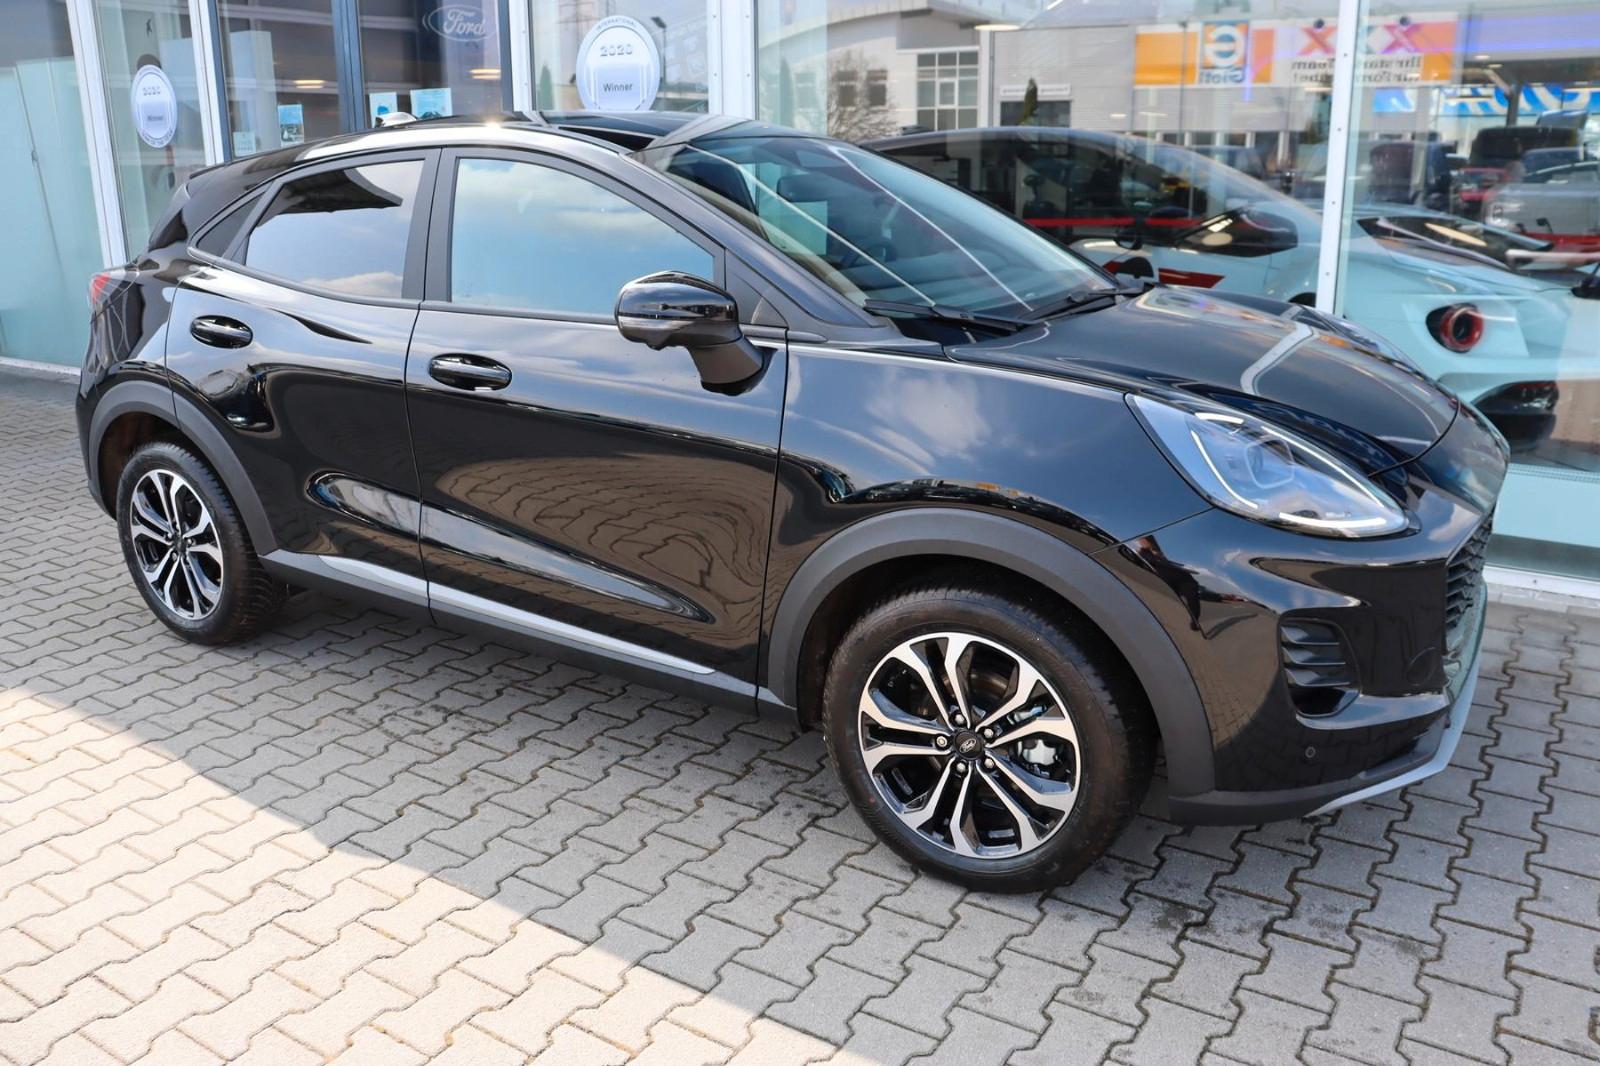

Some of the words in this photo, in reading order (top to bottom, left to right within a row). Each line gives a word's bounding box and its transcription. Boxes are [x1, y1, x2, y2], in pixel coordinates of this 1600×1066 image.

[443, 8, 486, 35] Ford
[600, 43, 633, 57] 2020
[602, 82, 634, 93] Winner
